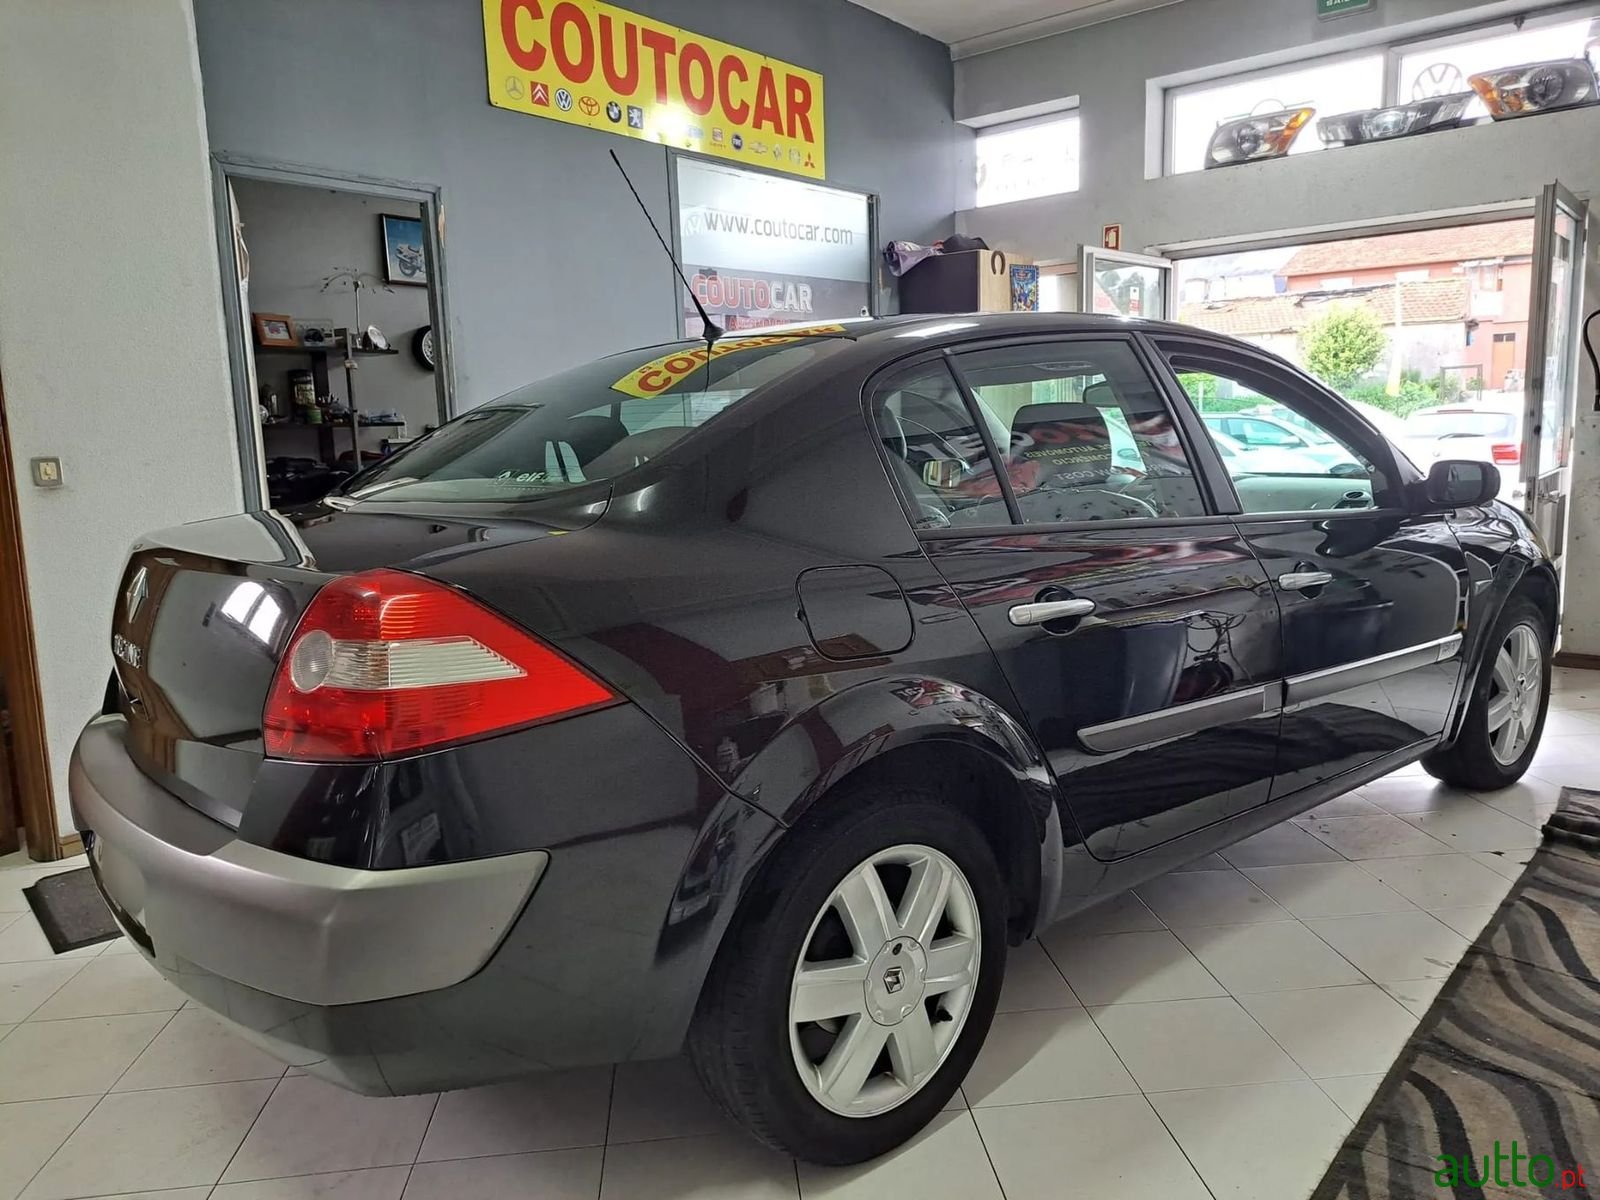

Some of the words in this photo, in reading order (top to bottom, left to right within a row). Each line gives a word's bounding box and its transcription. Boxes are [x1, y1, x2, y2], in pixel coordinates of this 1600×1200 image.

[500, 0, 814, 143] COUTOCAR
[703, 212, 853, 245] www.coutocar.com
[692, 273, 813, 313] COUTOCAR
